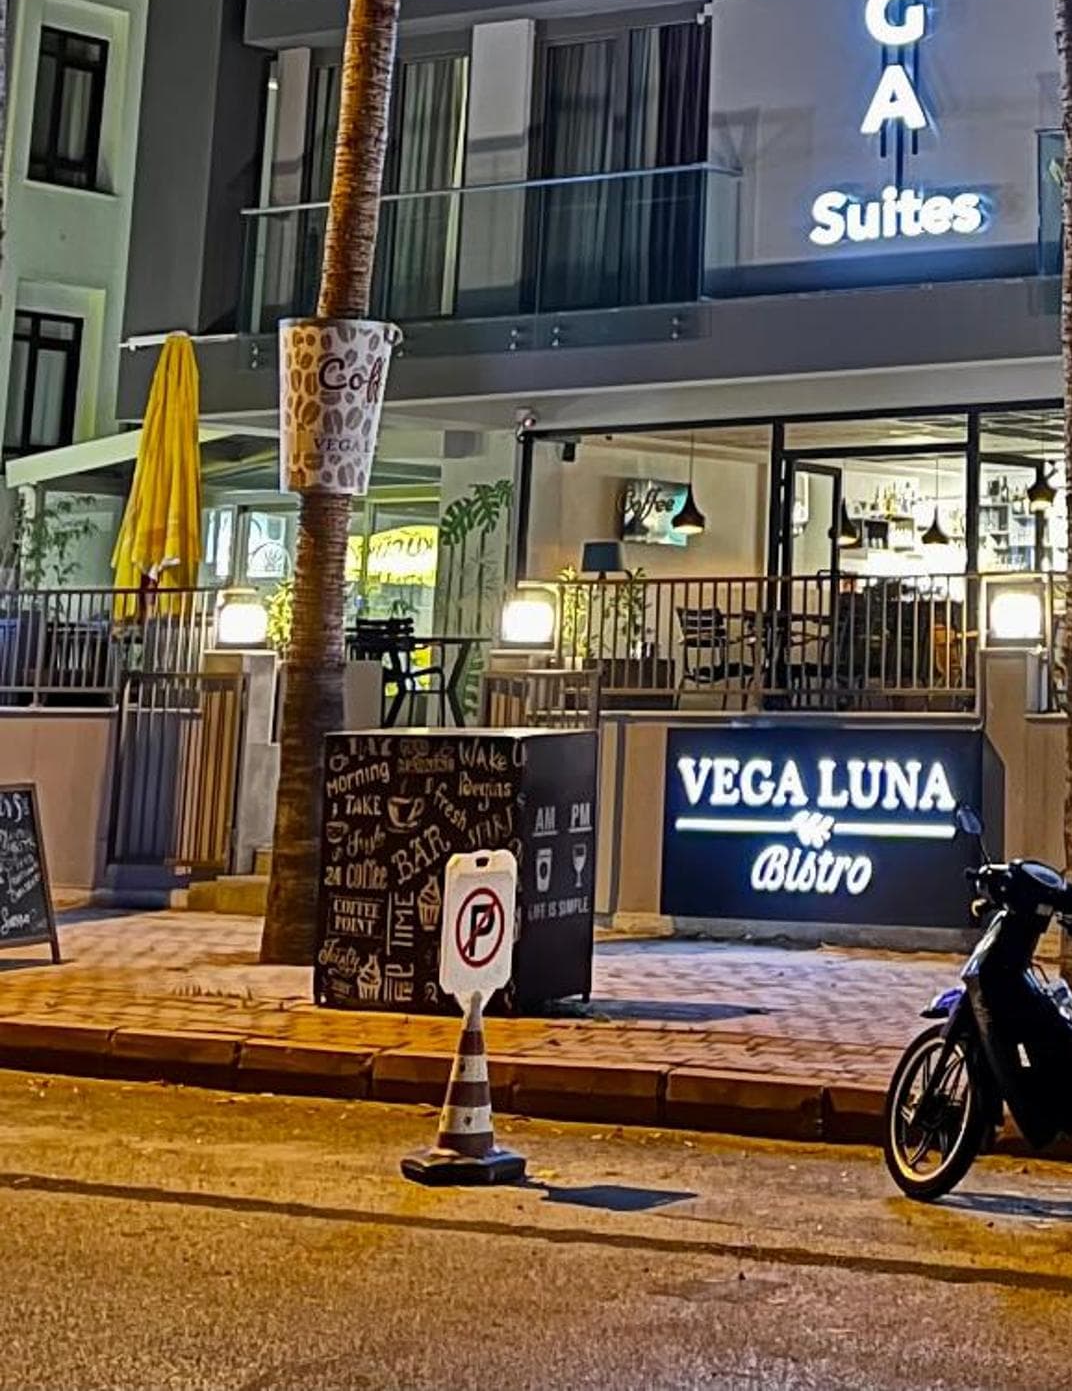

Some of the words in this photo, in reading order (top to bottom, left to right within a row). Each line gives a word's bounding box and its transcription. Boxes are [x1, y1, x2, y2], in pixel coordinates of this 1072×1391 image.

[809, 184, 982, 245] Suites
[344, 794, 382, 816] TAKE
[677, 757, 808, 806] VEGA
[816, 759, 956, 811] LUNA
[535, 806, 556, 833] AM
[570, 802, 591, 829] PM
[391, 824, 451, 886] BAR
[750, 843, 873, 896] Bistro
